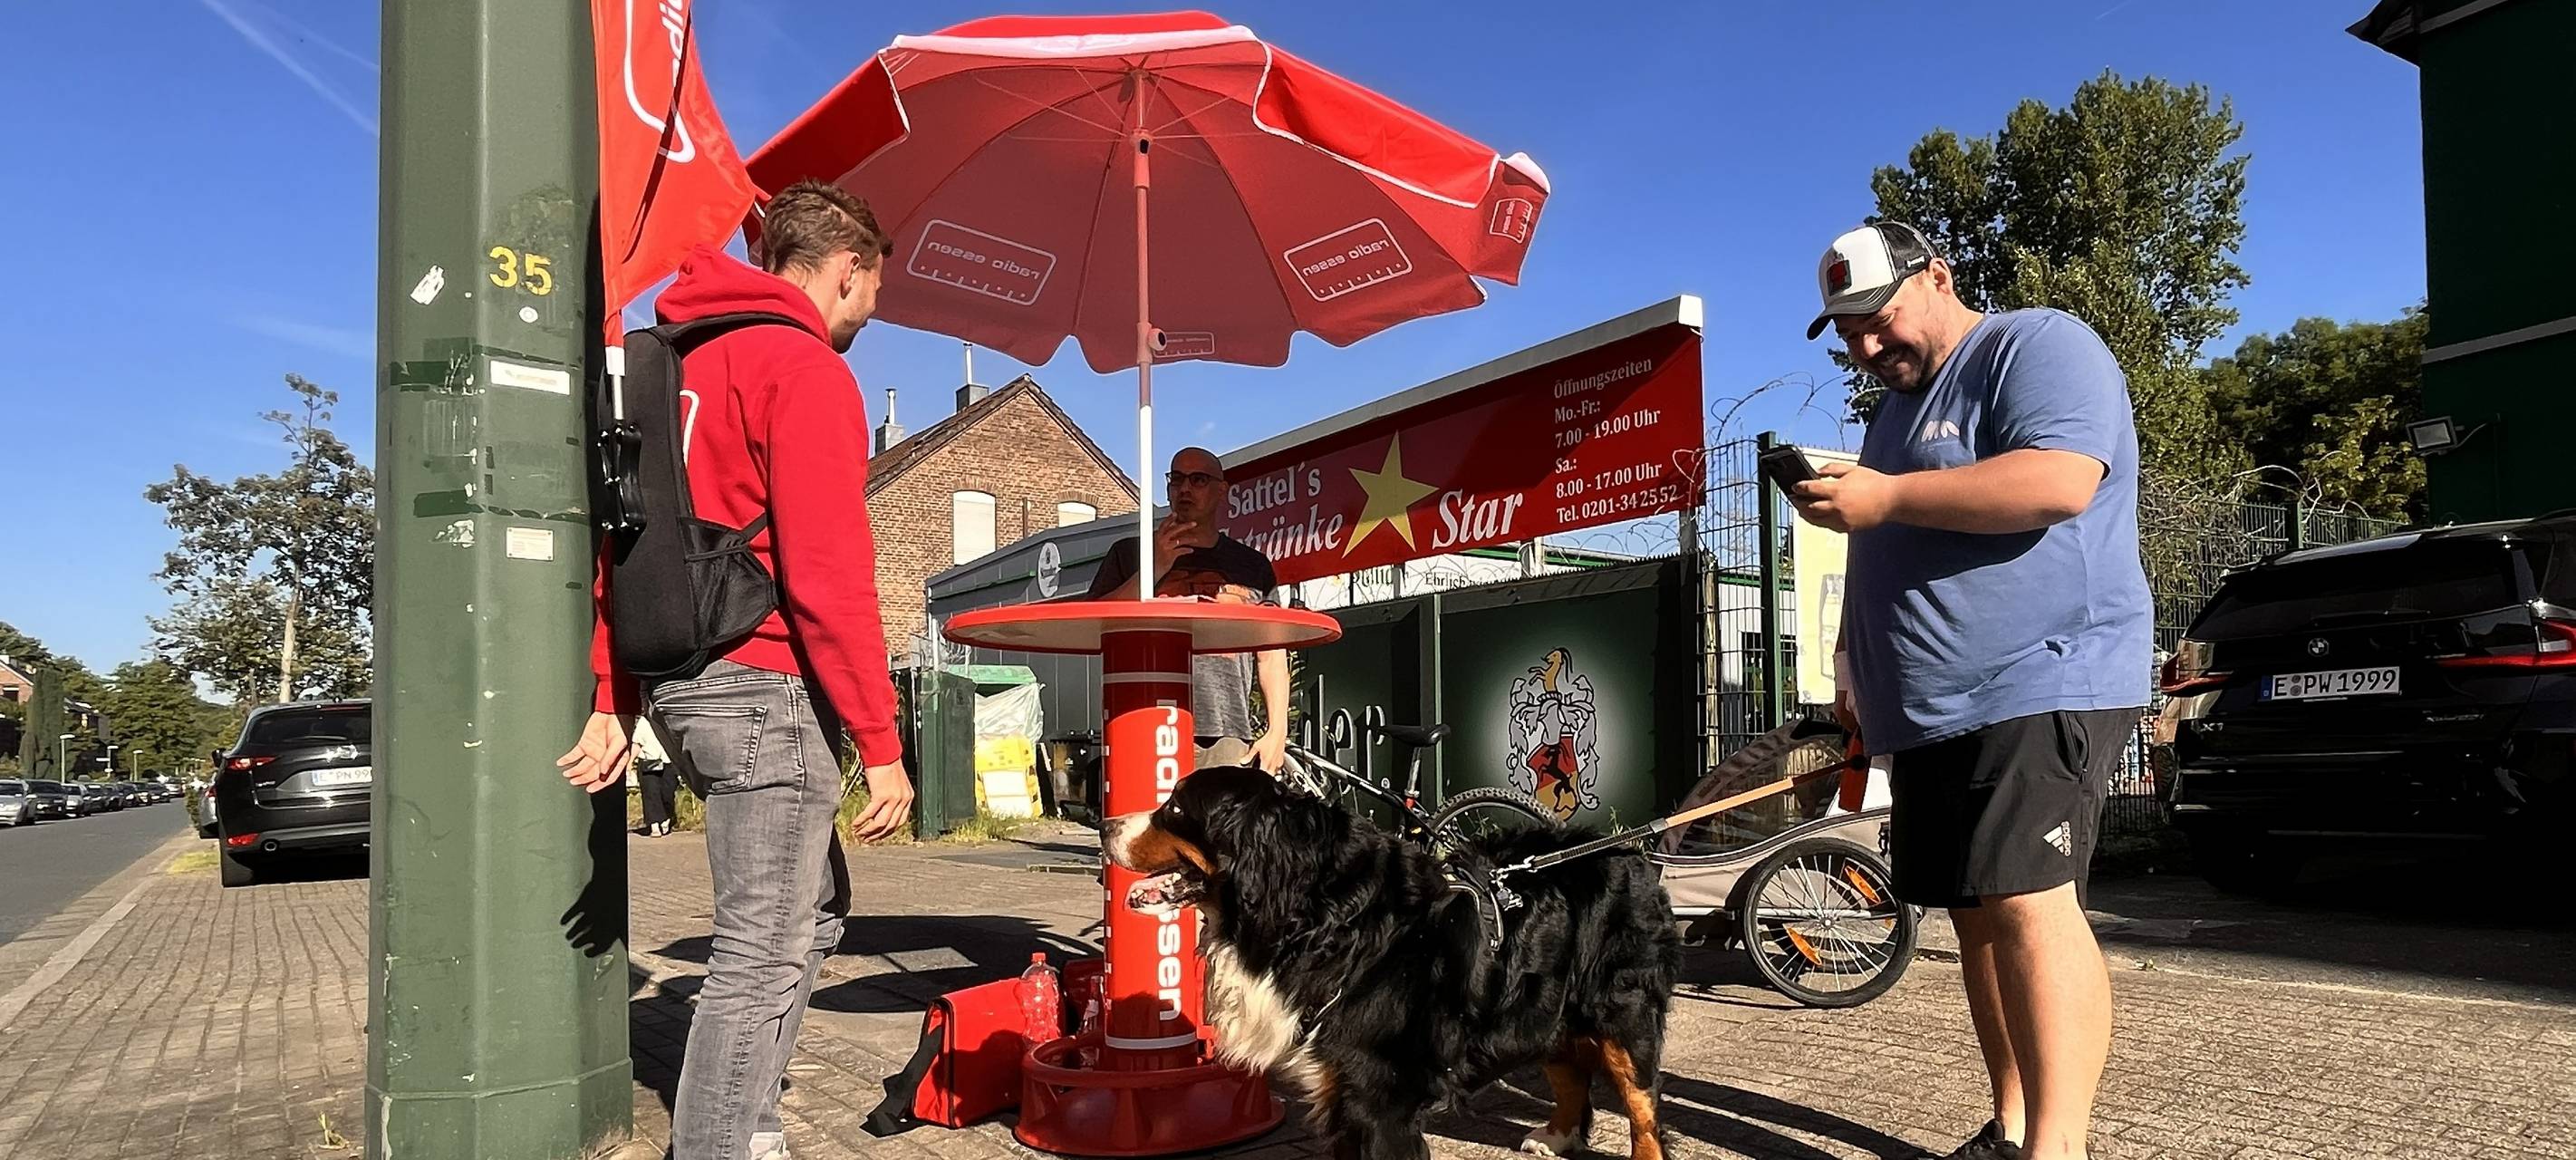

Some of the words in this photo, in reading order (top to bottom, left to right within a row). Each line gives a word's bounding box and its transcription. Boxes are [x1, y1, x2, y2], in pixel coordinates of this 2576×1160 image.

[489, 246, 552, 295] 35
[1554, 358, 1652, 399] Öffnungszeiten
[1555, 427, 1582, 449] 7.00
[1594, 414, 1631, 440] 19.00
[1634, 409, 1661, 429] Uhr
[1556, 478, 1584, 498] 8.00
[1595, 467, 1632, 491] 17.00
[1635, 462, 1663, 481] Uhr
[1432, 489, 1524, 550] Star
[1556, 507, 1579, 524] Tel.
[2274, 677, 2287, 696] E
[2303, 673, 2332, 694] PW
[2336, 669, 2397, 692] 1999
[2061, 820, 2071, 856] adidas
